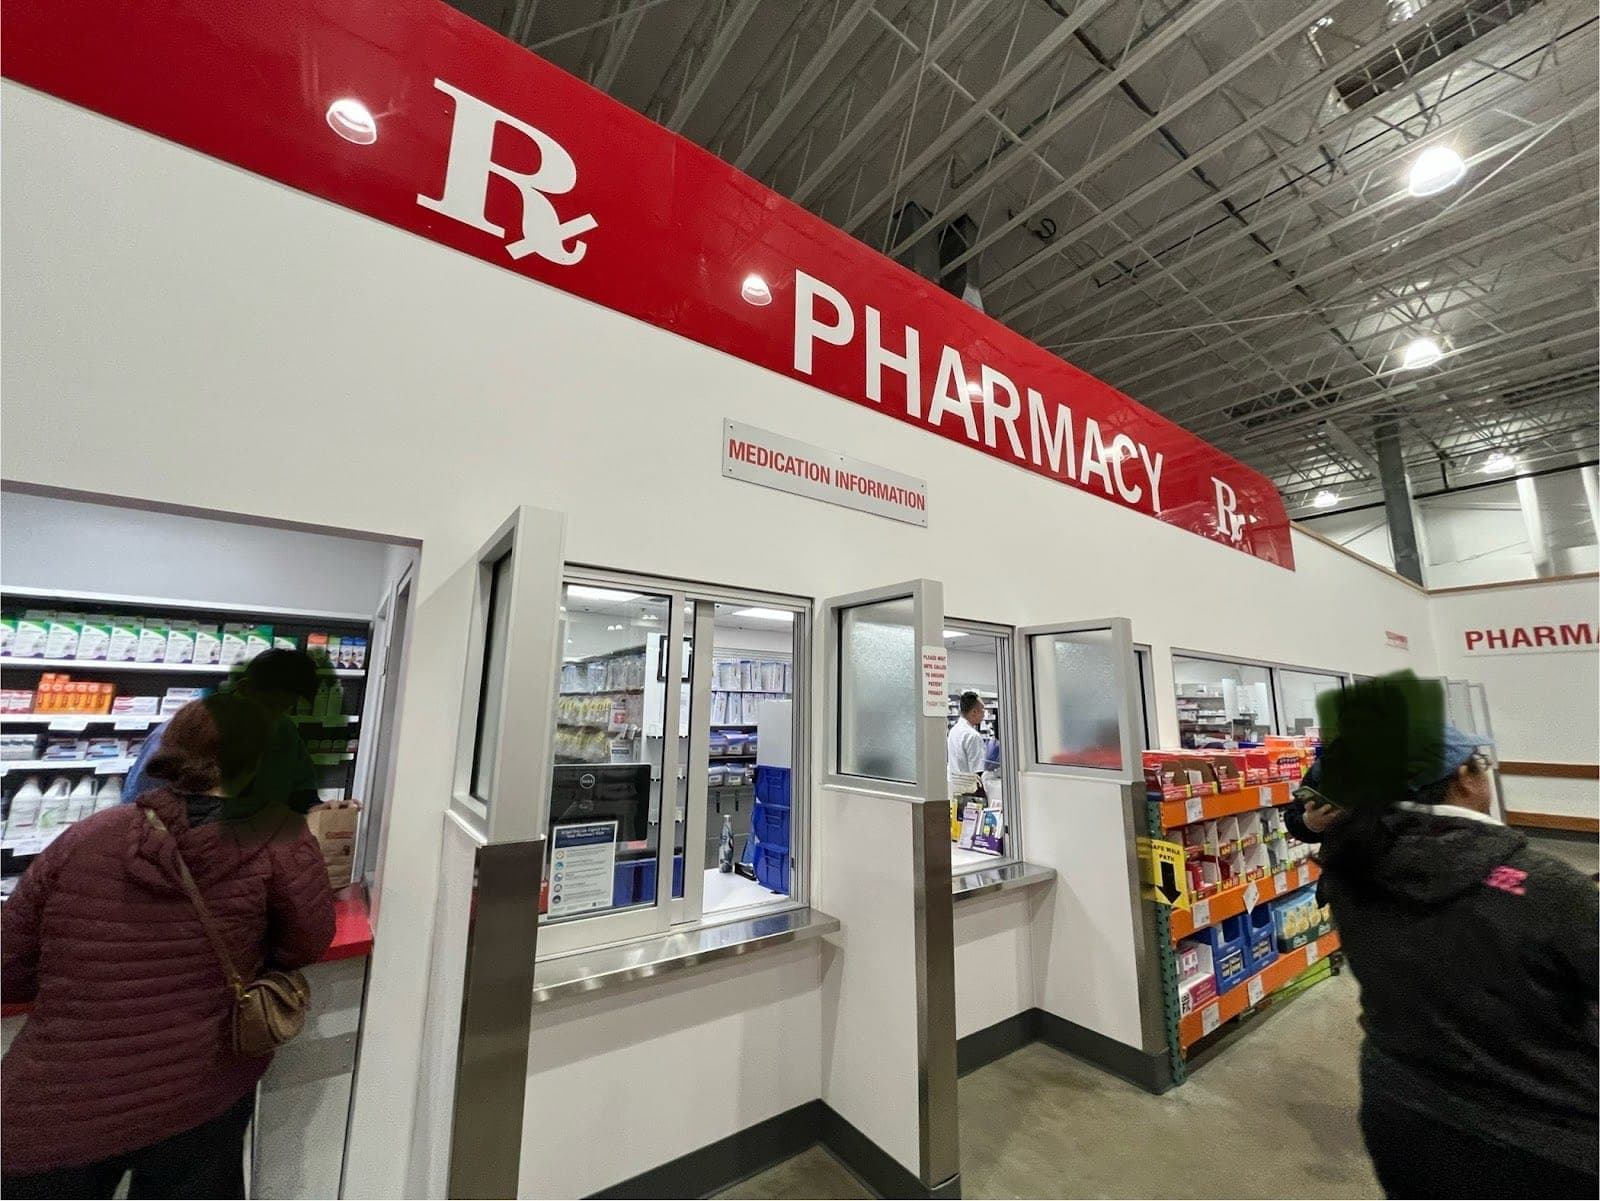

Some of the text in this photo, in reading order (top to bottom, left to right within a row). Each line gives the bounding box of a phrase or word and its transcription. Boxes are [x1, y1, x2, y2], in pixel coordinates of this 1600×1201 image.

[794, 269, 1164, 513] PHARMACY
[729, 438, 925, 511] MEDICATION INFORMATION
[1465, 623, 1599, 650] PHARM
